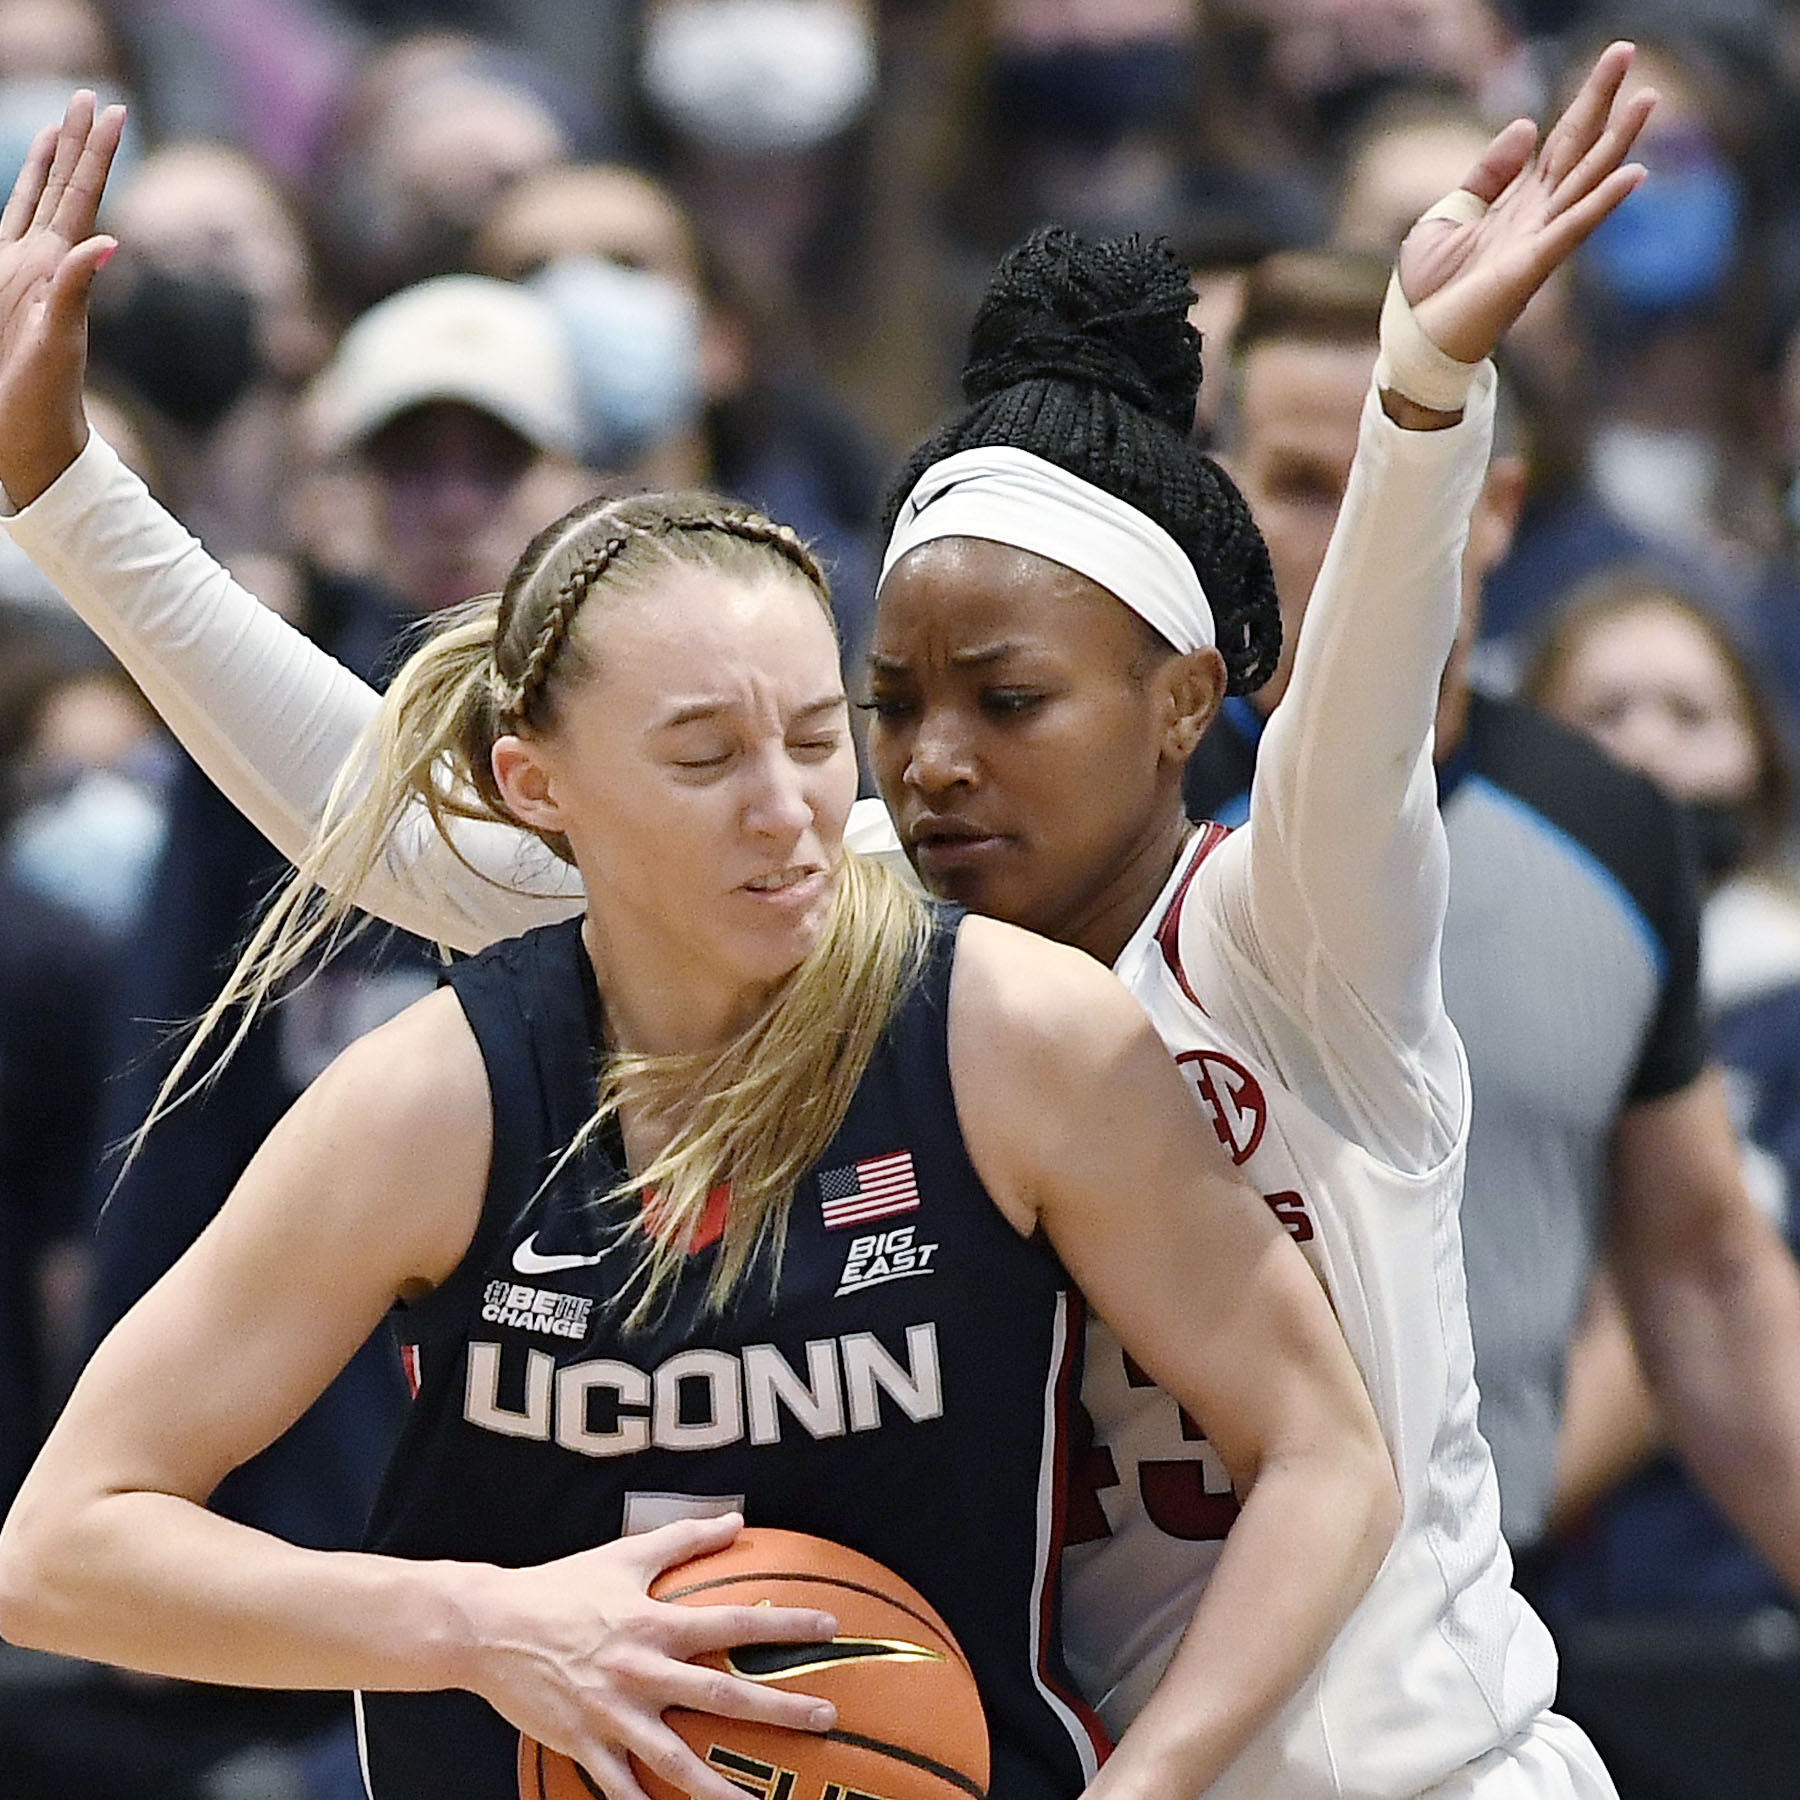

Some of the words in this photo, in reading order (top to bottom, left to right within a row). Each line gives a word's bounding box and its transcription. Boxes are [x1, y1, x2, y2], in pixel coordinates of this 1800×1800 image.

[847, 1225, 916, 1261] BIG
[840, 1243, 939, 1285] EAST
[482, 1304, 588, 1340] CHANGE
[463, 1322, 944, 1458] UCONN
